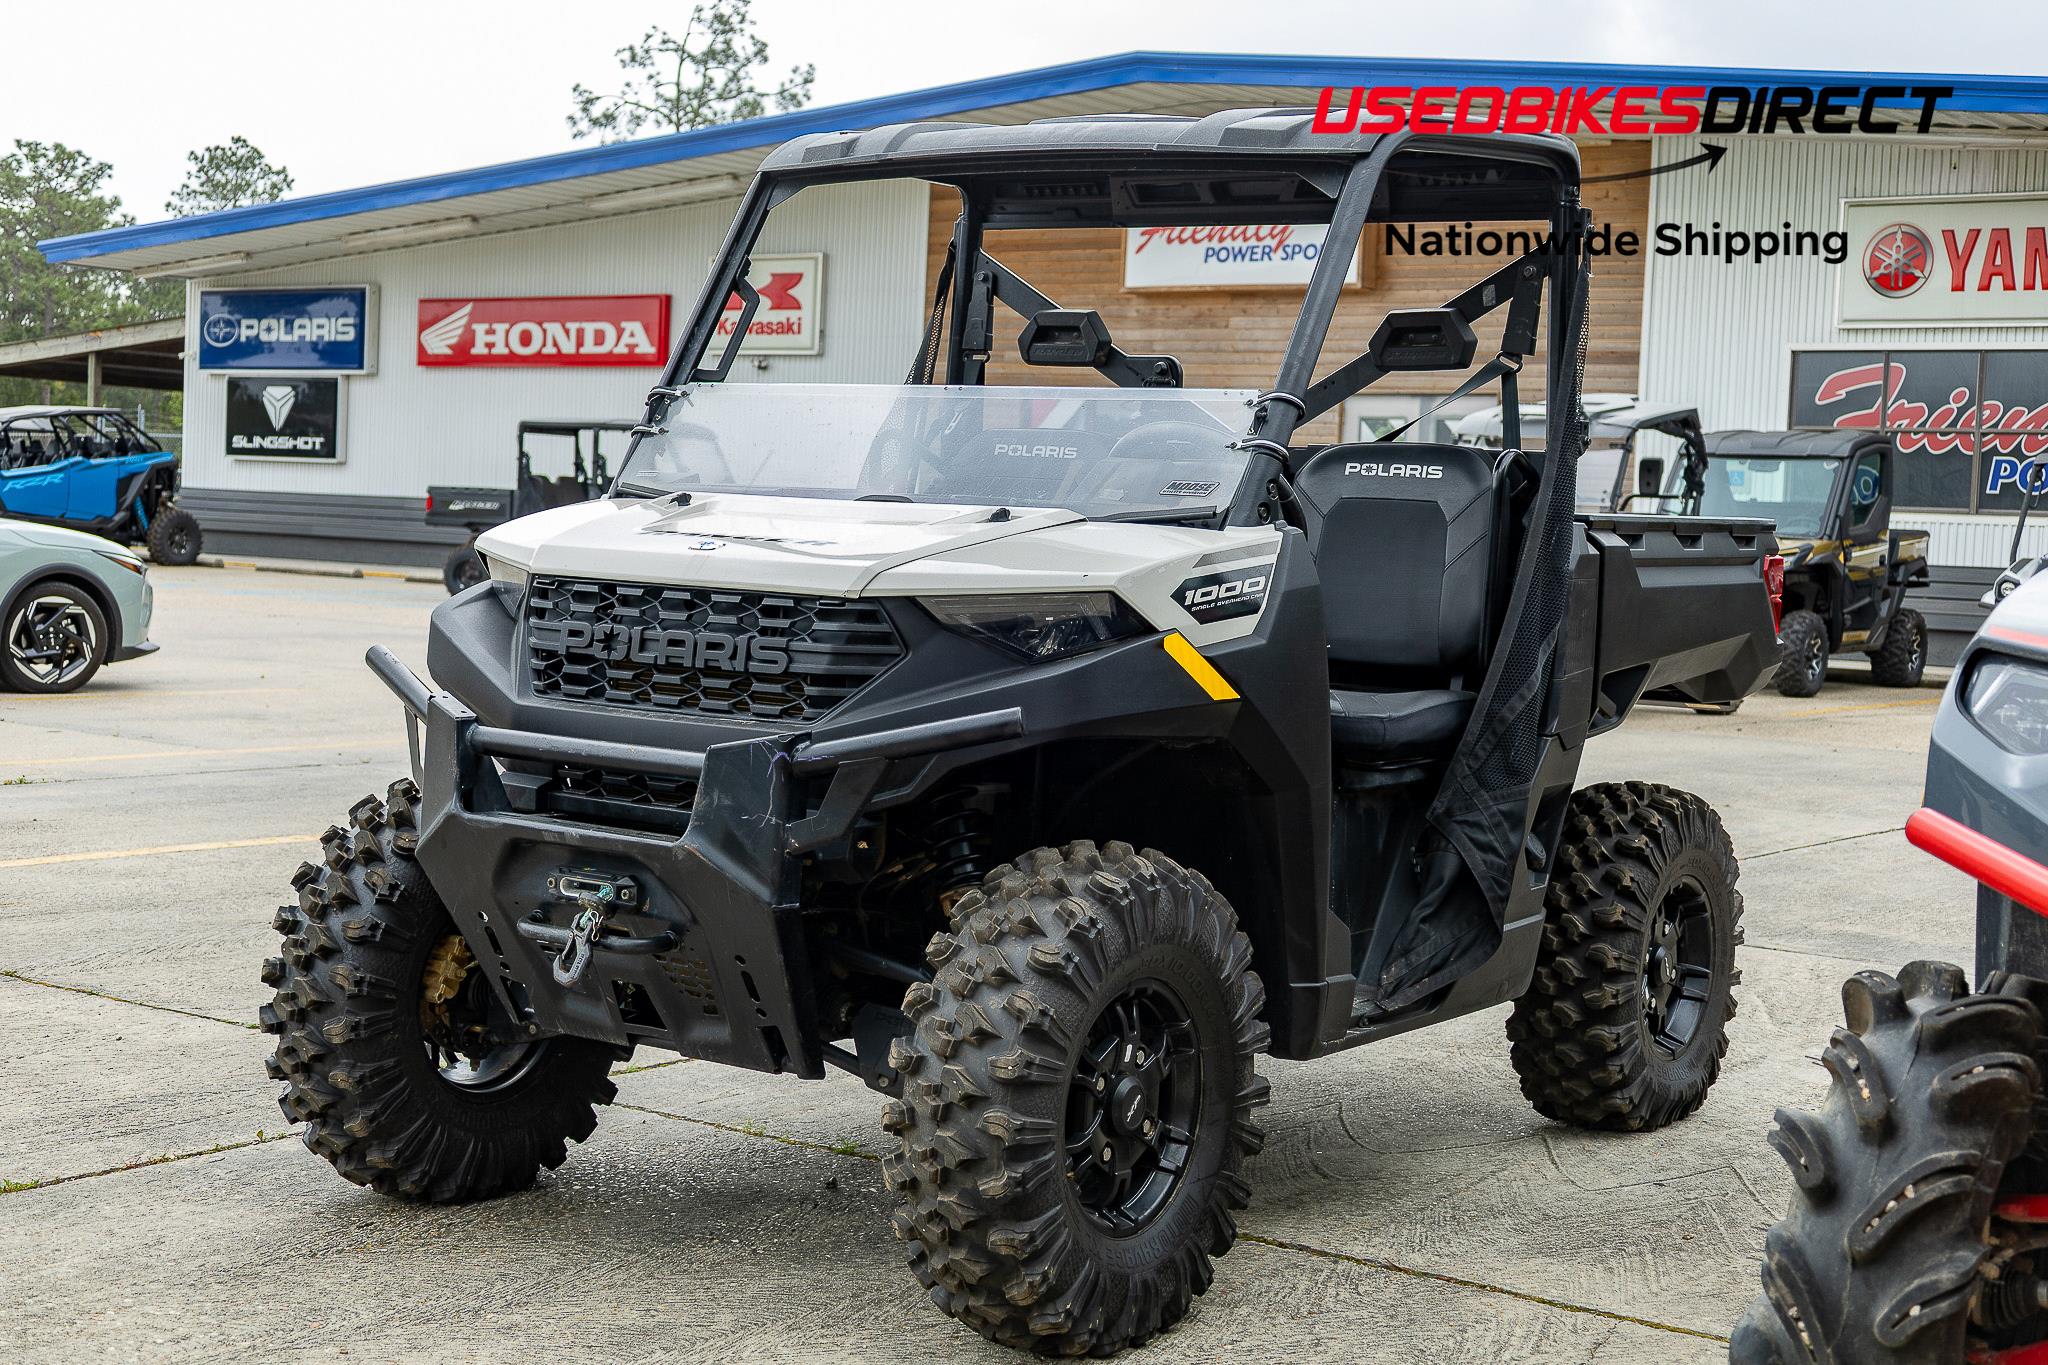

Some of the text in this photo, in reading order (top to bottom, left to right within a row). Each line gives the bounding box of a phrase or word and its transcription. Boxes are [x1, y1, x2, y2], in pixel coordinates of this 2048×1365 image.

[1205, 243, 1321, 263] POWER SPO
[240, 317, 355, 342] POLARIS
[717, 317, 802, 335] Kaasaki
[470, 321, 656, 355] HONDA
[232, 435, 325, 450] SLINGSHOT
[994, 443, 1078, 459] POLARIS
[1344, 462, 1443, 479] POLARIS
[1166, 481, 1216, 491] MOOSE
[1184, 575, 1266, 605] 1000
[560, 620, 793, 676] POLARIS
